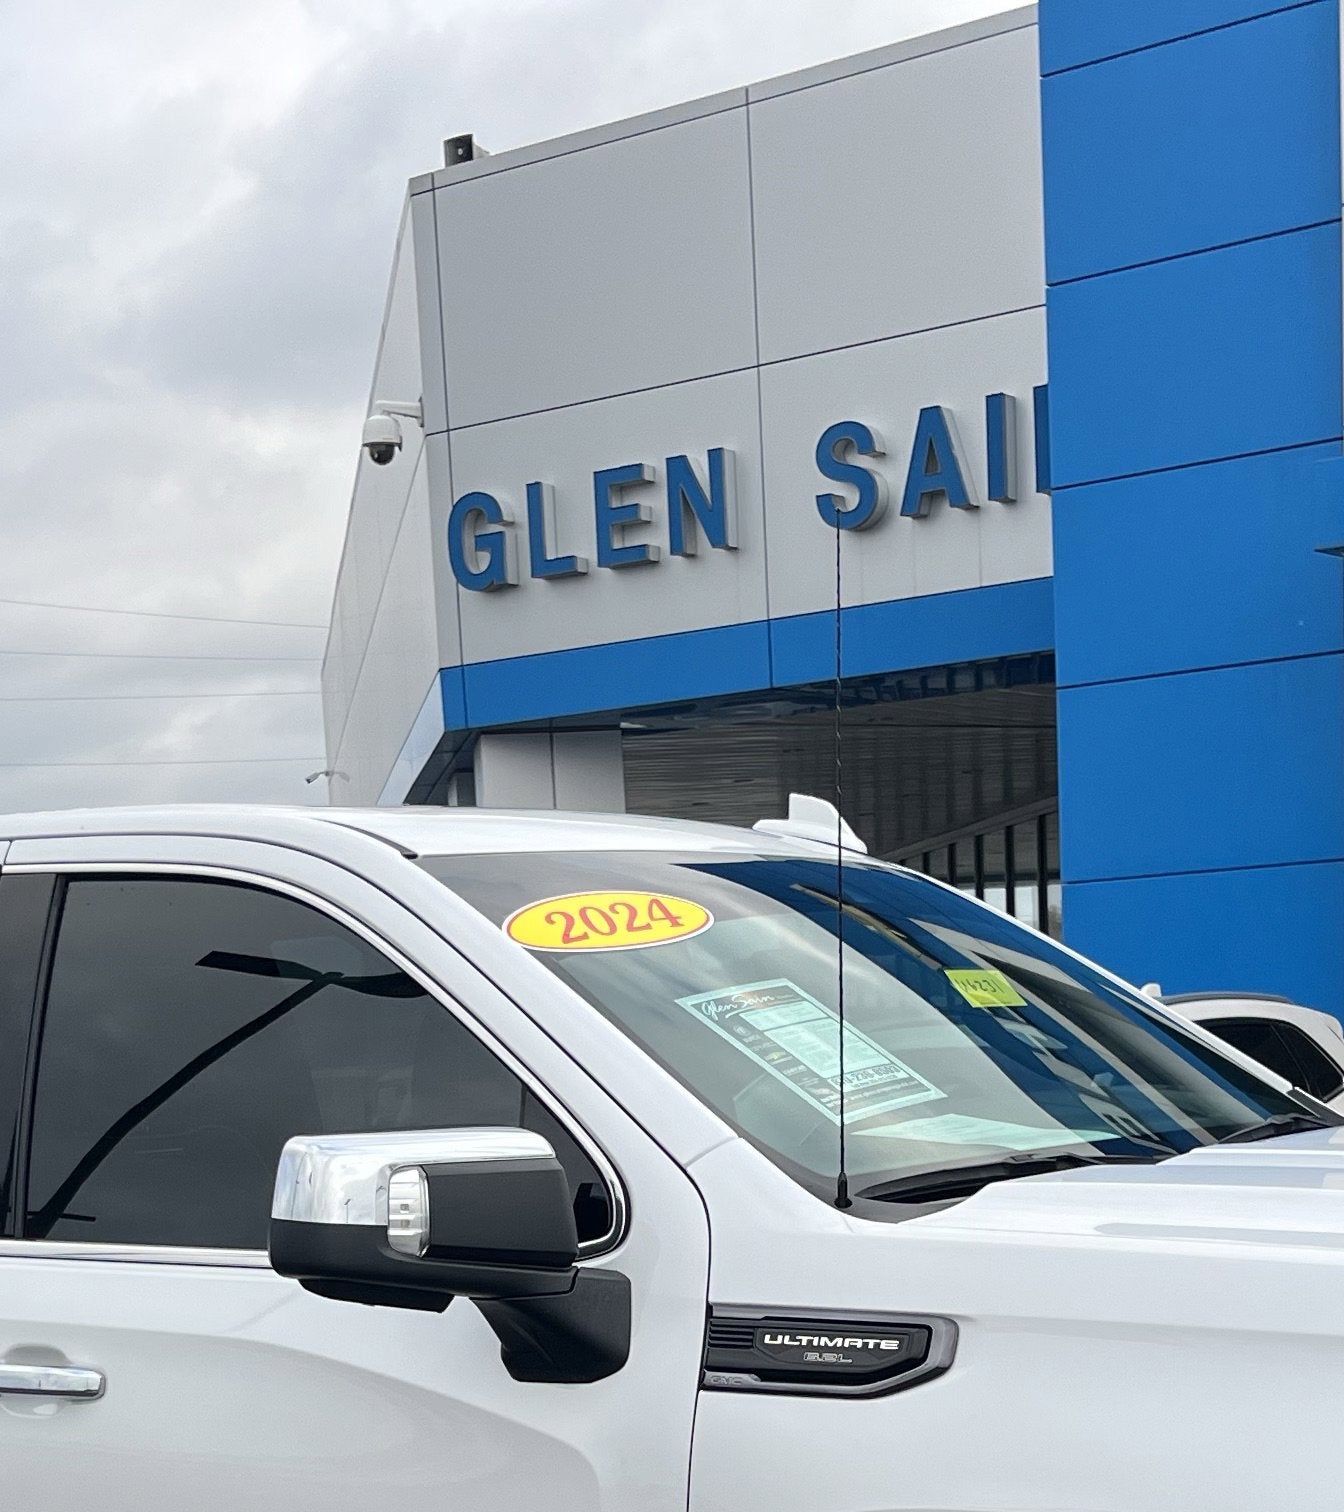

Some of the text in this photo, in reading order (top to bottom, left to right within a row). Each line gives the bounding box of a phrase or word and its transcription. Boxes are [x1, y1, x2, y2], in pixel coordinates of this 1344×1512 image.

[447, 446, 738, 593] GLEN
[544, 897, 682, 945] 2024
[763, 1333, 900, 1350] ULTIMATE
